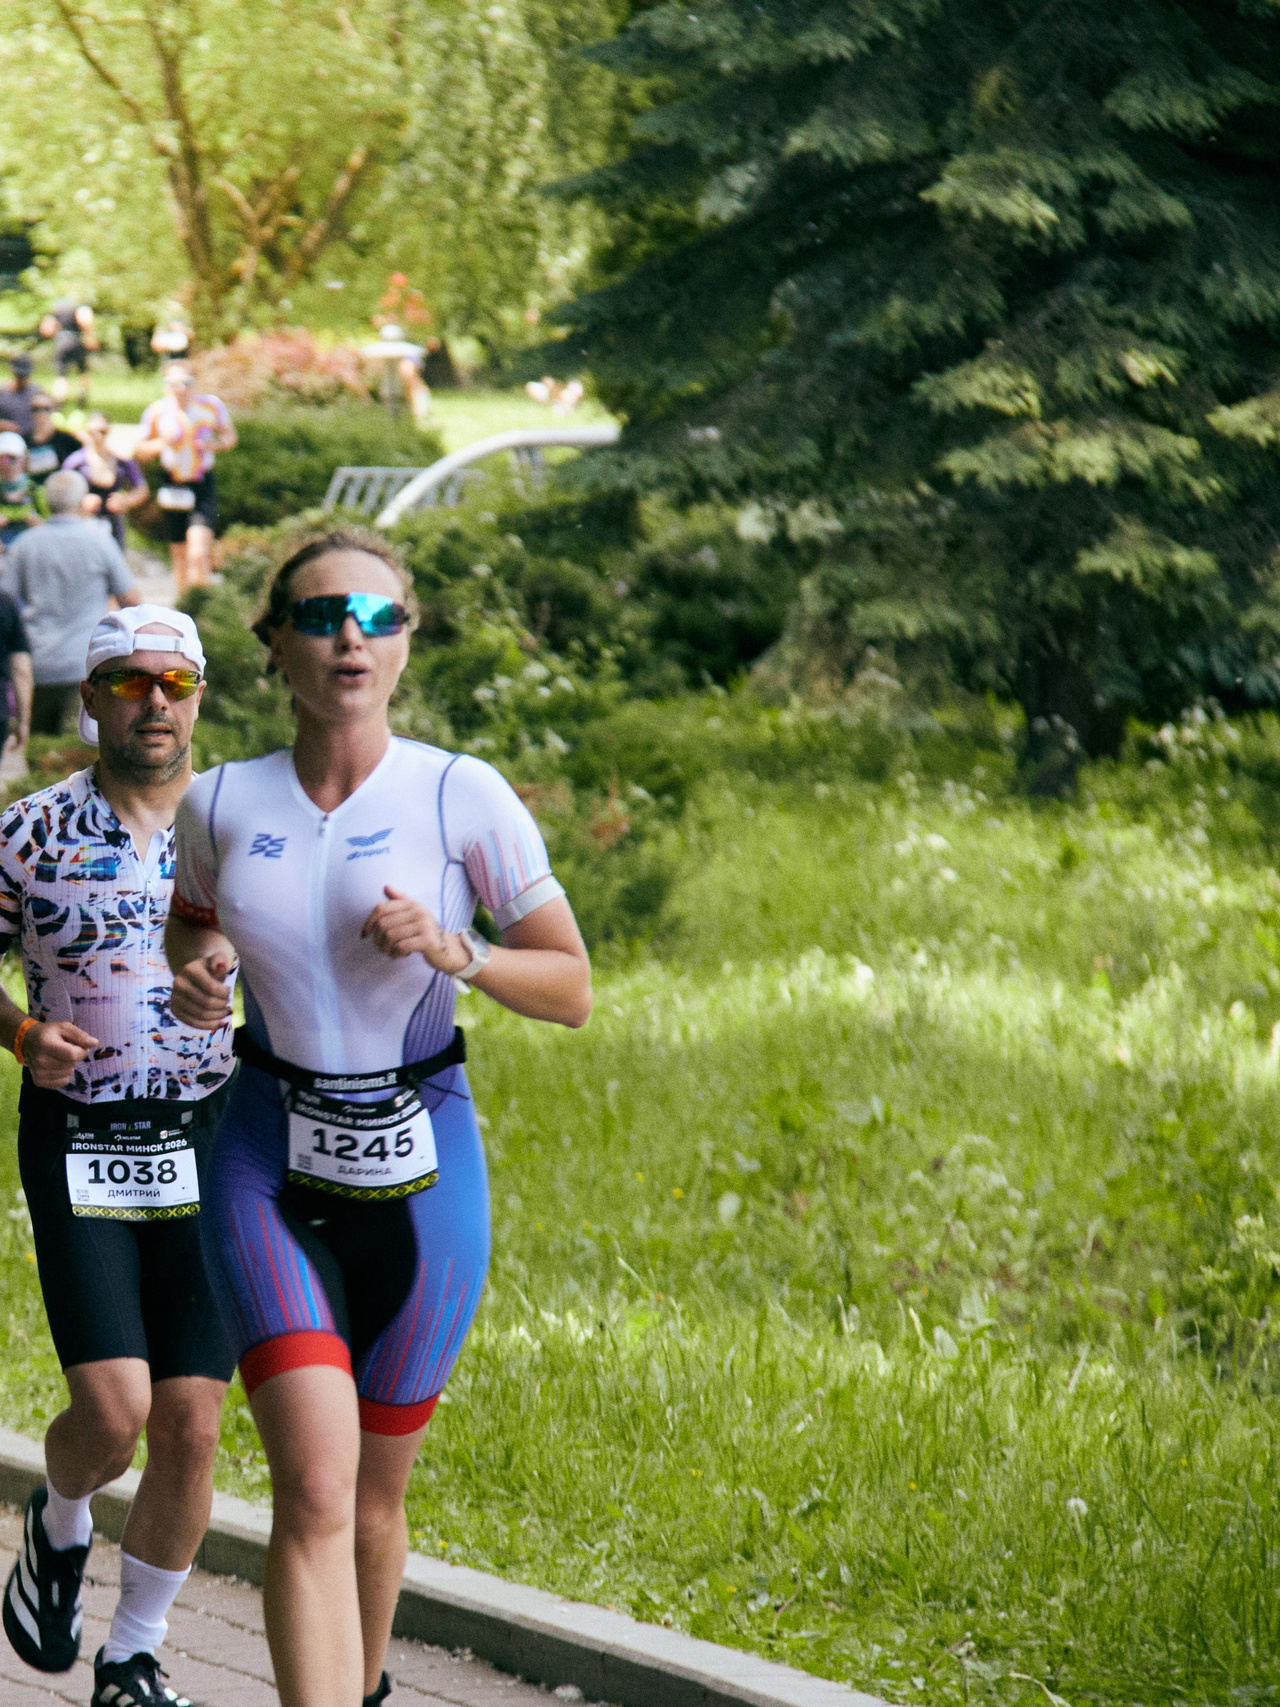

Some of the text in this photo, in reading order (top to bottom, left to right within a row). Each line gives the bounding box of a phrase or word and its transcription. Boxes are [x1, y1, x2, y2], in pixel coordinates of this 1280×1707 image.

[313, 1071, 397, 1090] santinisms.it
[134, 1120, 152, 1130] STAR
[71, 1138, 188, 1153] IRONSTAR МИНСК 2026
[312, 1127, 415, 1162] 1245
[88, 1158, 178, 1185] 1038
[337, 1165, 393, 1176] ДАРИНА
[107, 1188, 161, 1199] ДМИТРИЙ
